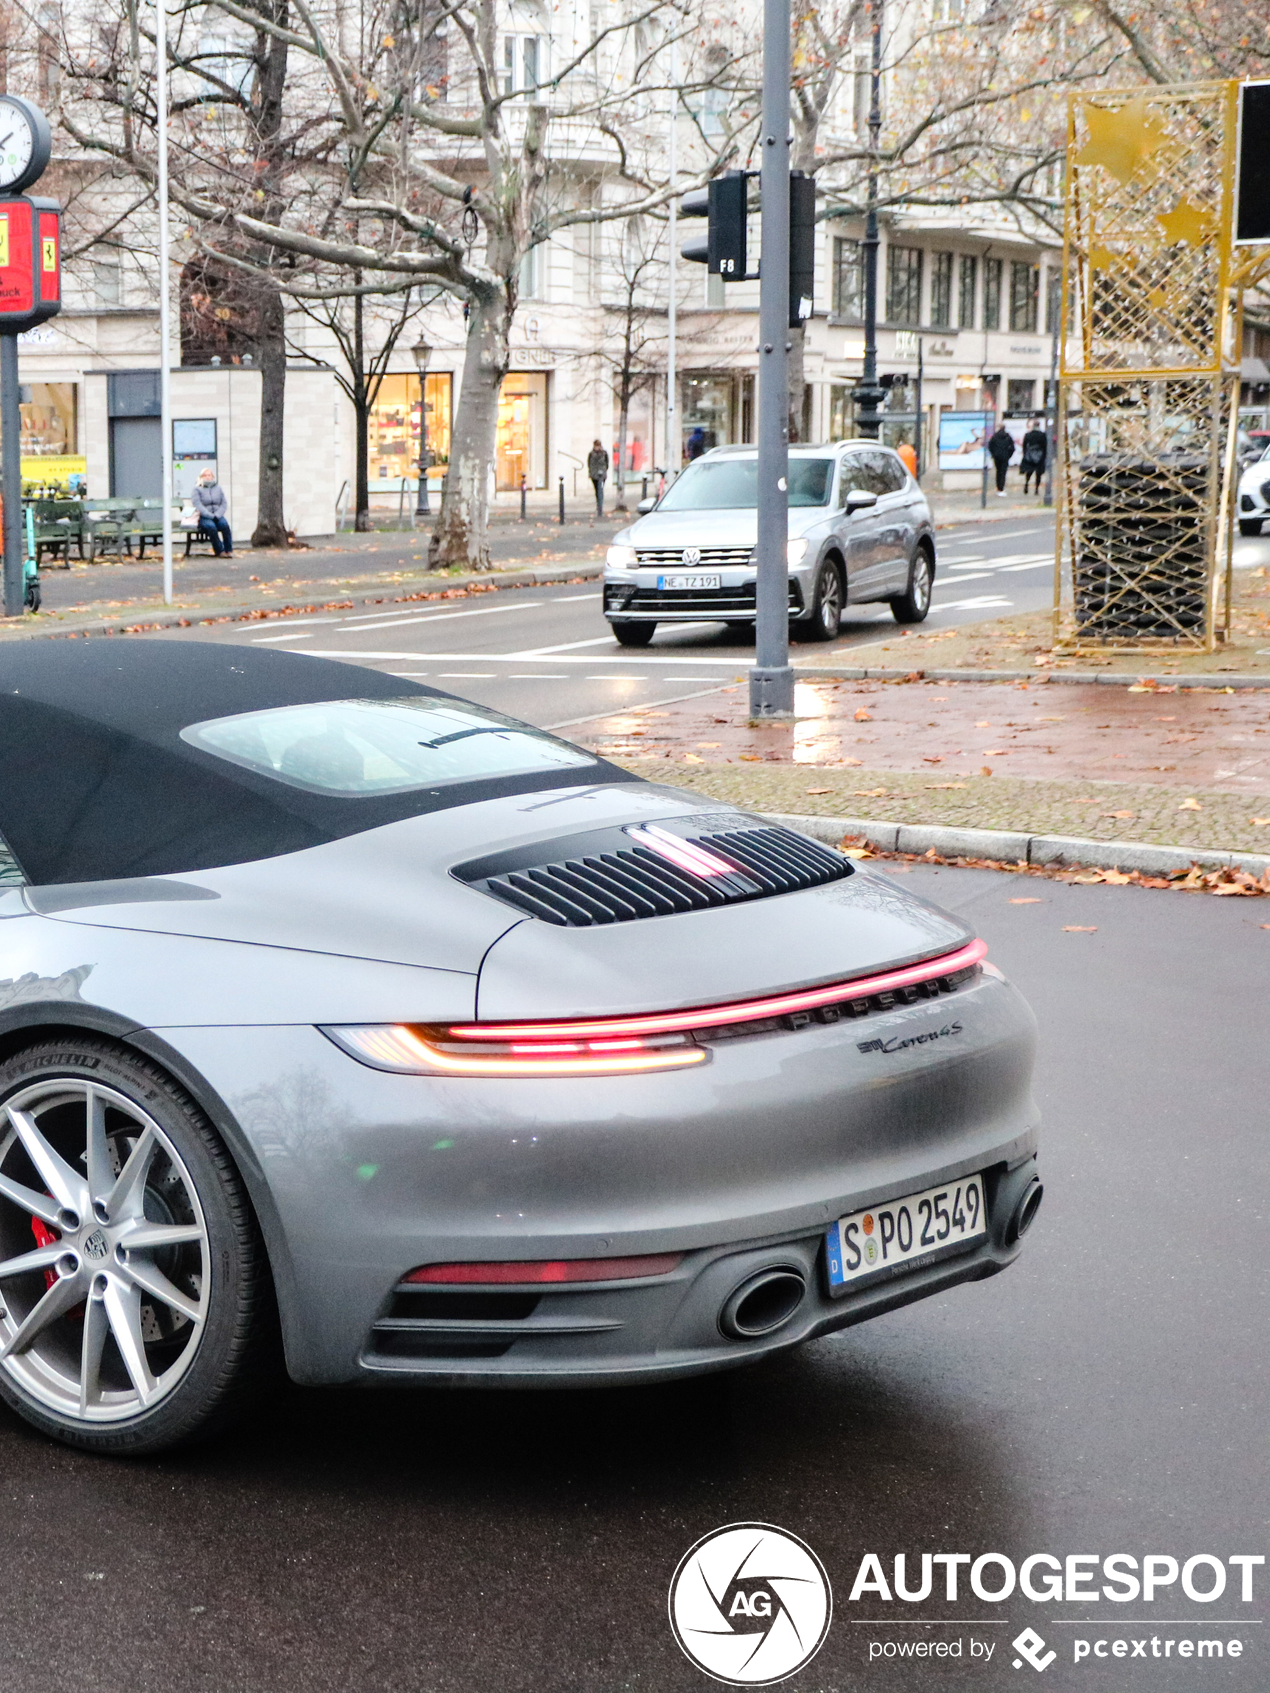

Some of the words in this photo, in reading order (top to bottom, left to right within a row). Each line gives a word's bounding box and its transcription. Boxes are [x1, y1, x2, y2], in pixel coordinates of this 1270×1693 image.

[719, 258, 735, 273] F8
[664, 577, 677, 588] NE
[684, 577, 698, 587] TZ
[700, 577, 718, 587] 191
[24, 1054, 96, 1070] MICHELIN
[844, 1222, 862, 1271] S
[878, 1205, 913, 1259] PO
[918, 1182, 980, 1247] 2549
[831, 1258, 838, 1274] D
